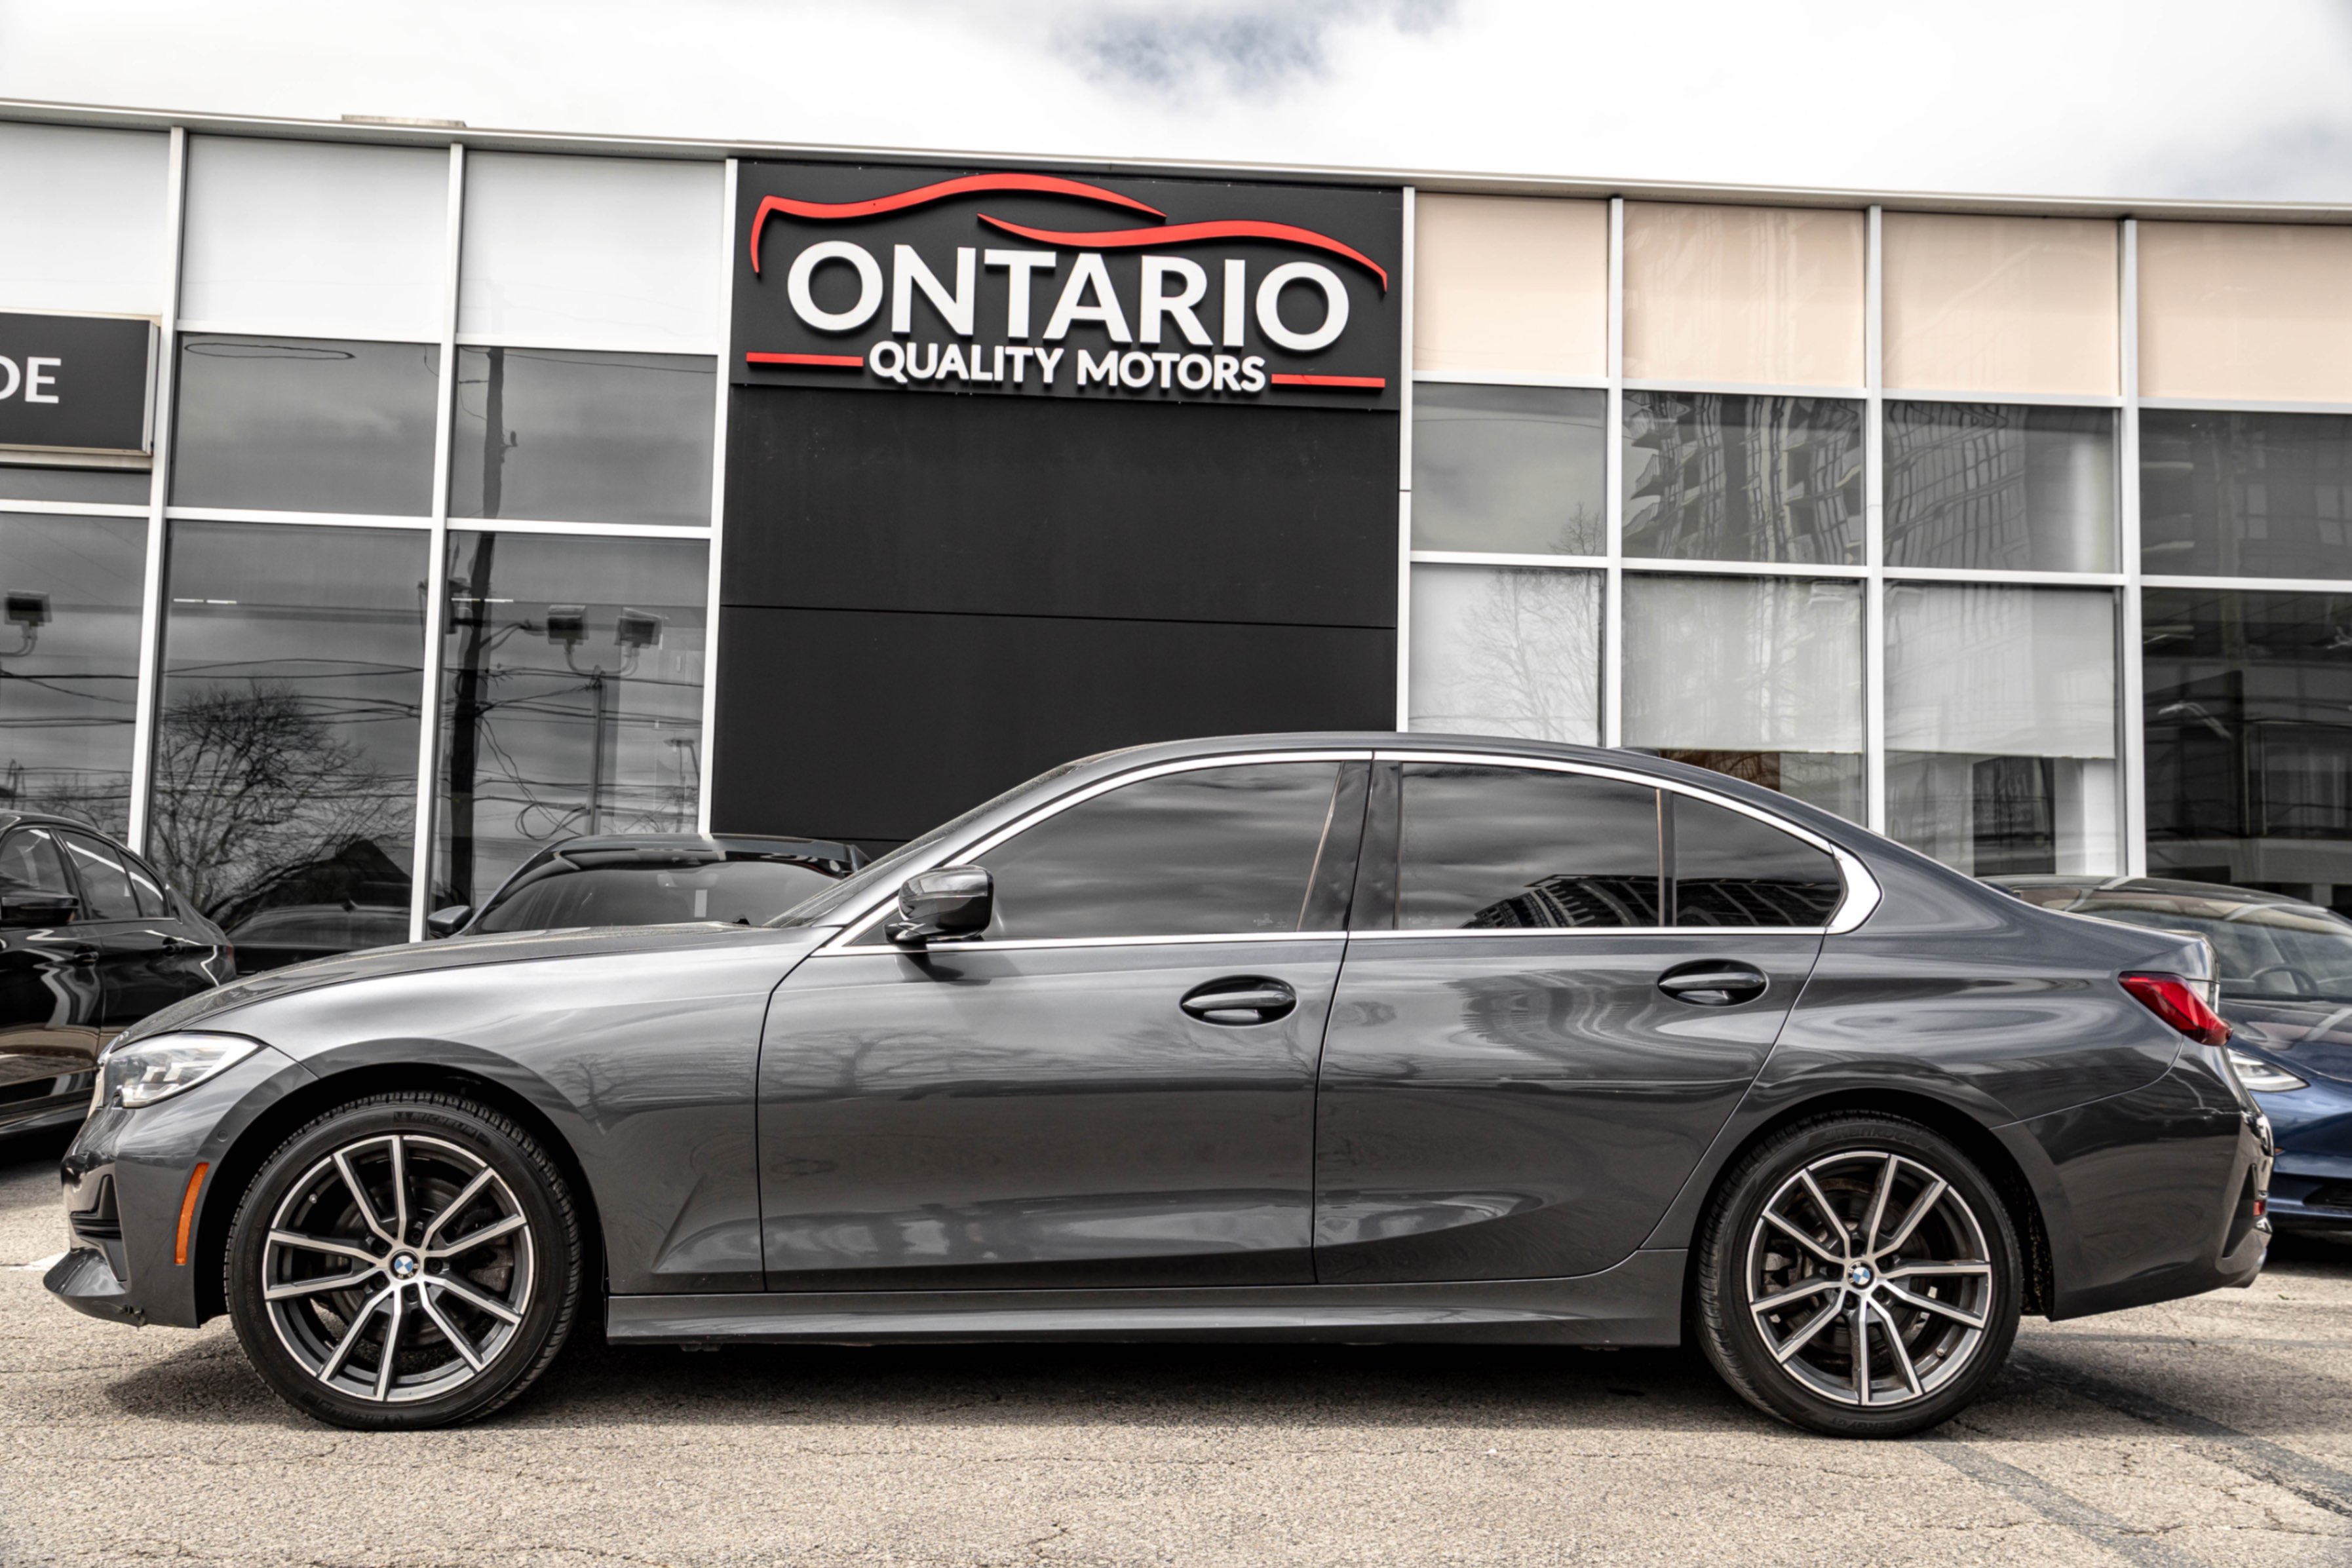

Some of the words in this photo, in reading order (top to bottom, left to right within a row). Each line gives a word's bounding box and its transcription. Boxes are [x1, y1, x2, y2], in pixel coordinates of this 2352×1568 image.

[787, 240, 1349, 351] ONTARIO
[869, 340, 1064, 383] QUALITY
[1077, 349, 1266, 392] MOTORS
[409, 1111, 476, 1139] MICHELIN
